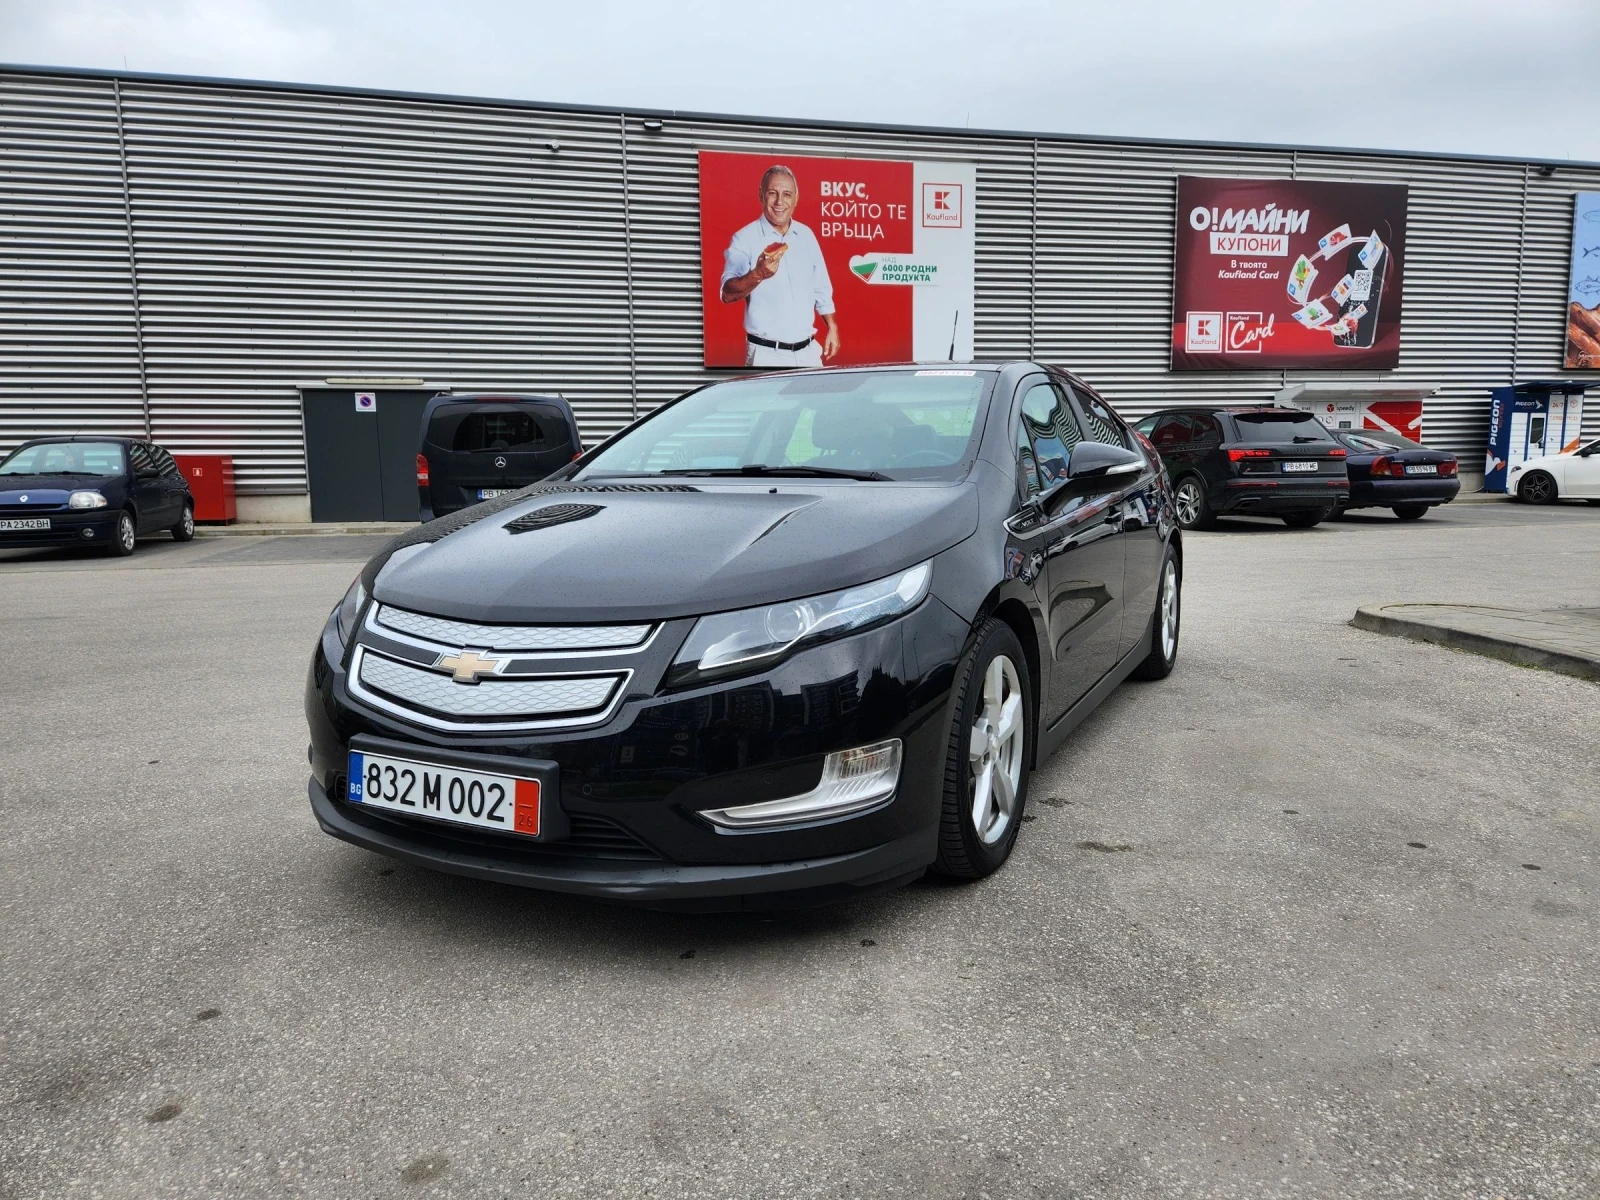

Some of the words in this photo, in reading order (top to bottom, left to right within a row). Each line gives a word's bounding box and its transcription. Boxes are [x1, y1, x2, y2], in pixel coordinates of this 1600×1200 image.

[820, 181, 869, 200] ВКУС,
[821, 200, 882, 219] КОЙТО
[886, 204, 907, 220] ТЕ
[926, 212, 958, 221] Kaufland
[821, 221, 885, 242] ВРЪЩА
[1217, 237, 1282, 252] КУПОНИ
[882, 256, 897, 264] НАД
[1230, 259, 1237, 268] В
[1239, 261, 1267, 269] твоята
[882, 264, 904, 272] 6000
[905, 264, 938, 274] РОДНИ
[1218, 269, 1258, 279] Kaufland
[1258, 270, 1280, 279] Card
[882, 273, 931, 283] ПРОДУКТА
[1230, 312, 1276, 349] Card
[1336, 404, 1355, 412] speedy
[1490, 399, 1501, 446] PIGEON
[484, 490, 494, 498] PB
[0, 520, 13, 529] PA
[13, 520, 36, 529] 2342
[36, 519, 49, 528] BH
[350, 783, 362, 795] BG
[366, 763, 416, 807] 832
[422, 771, 442, 812] M
[449, 777, 506, 822] 002
[517, 812, 533, 828] 26
